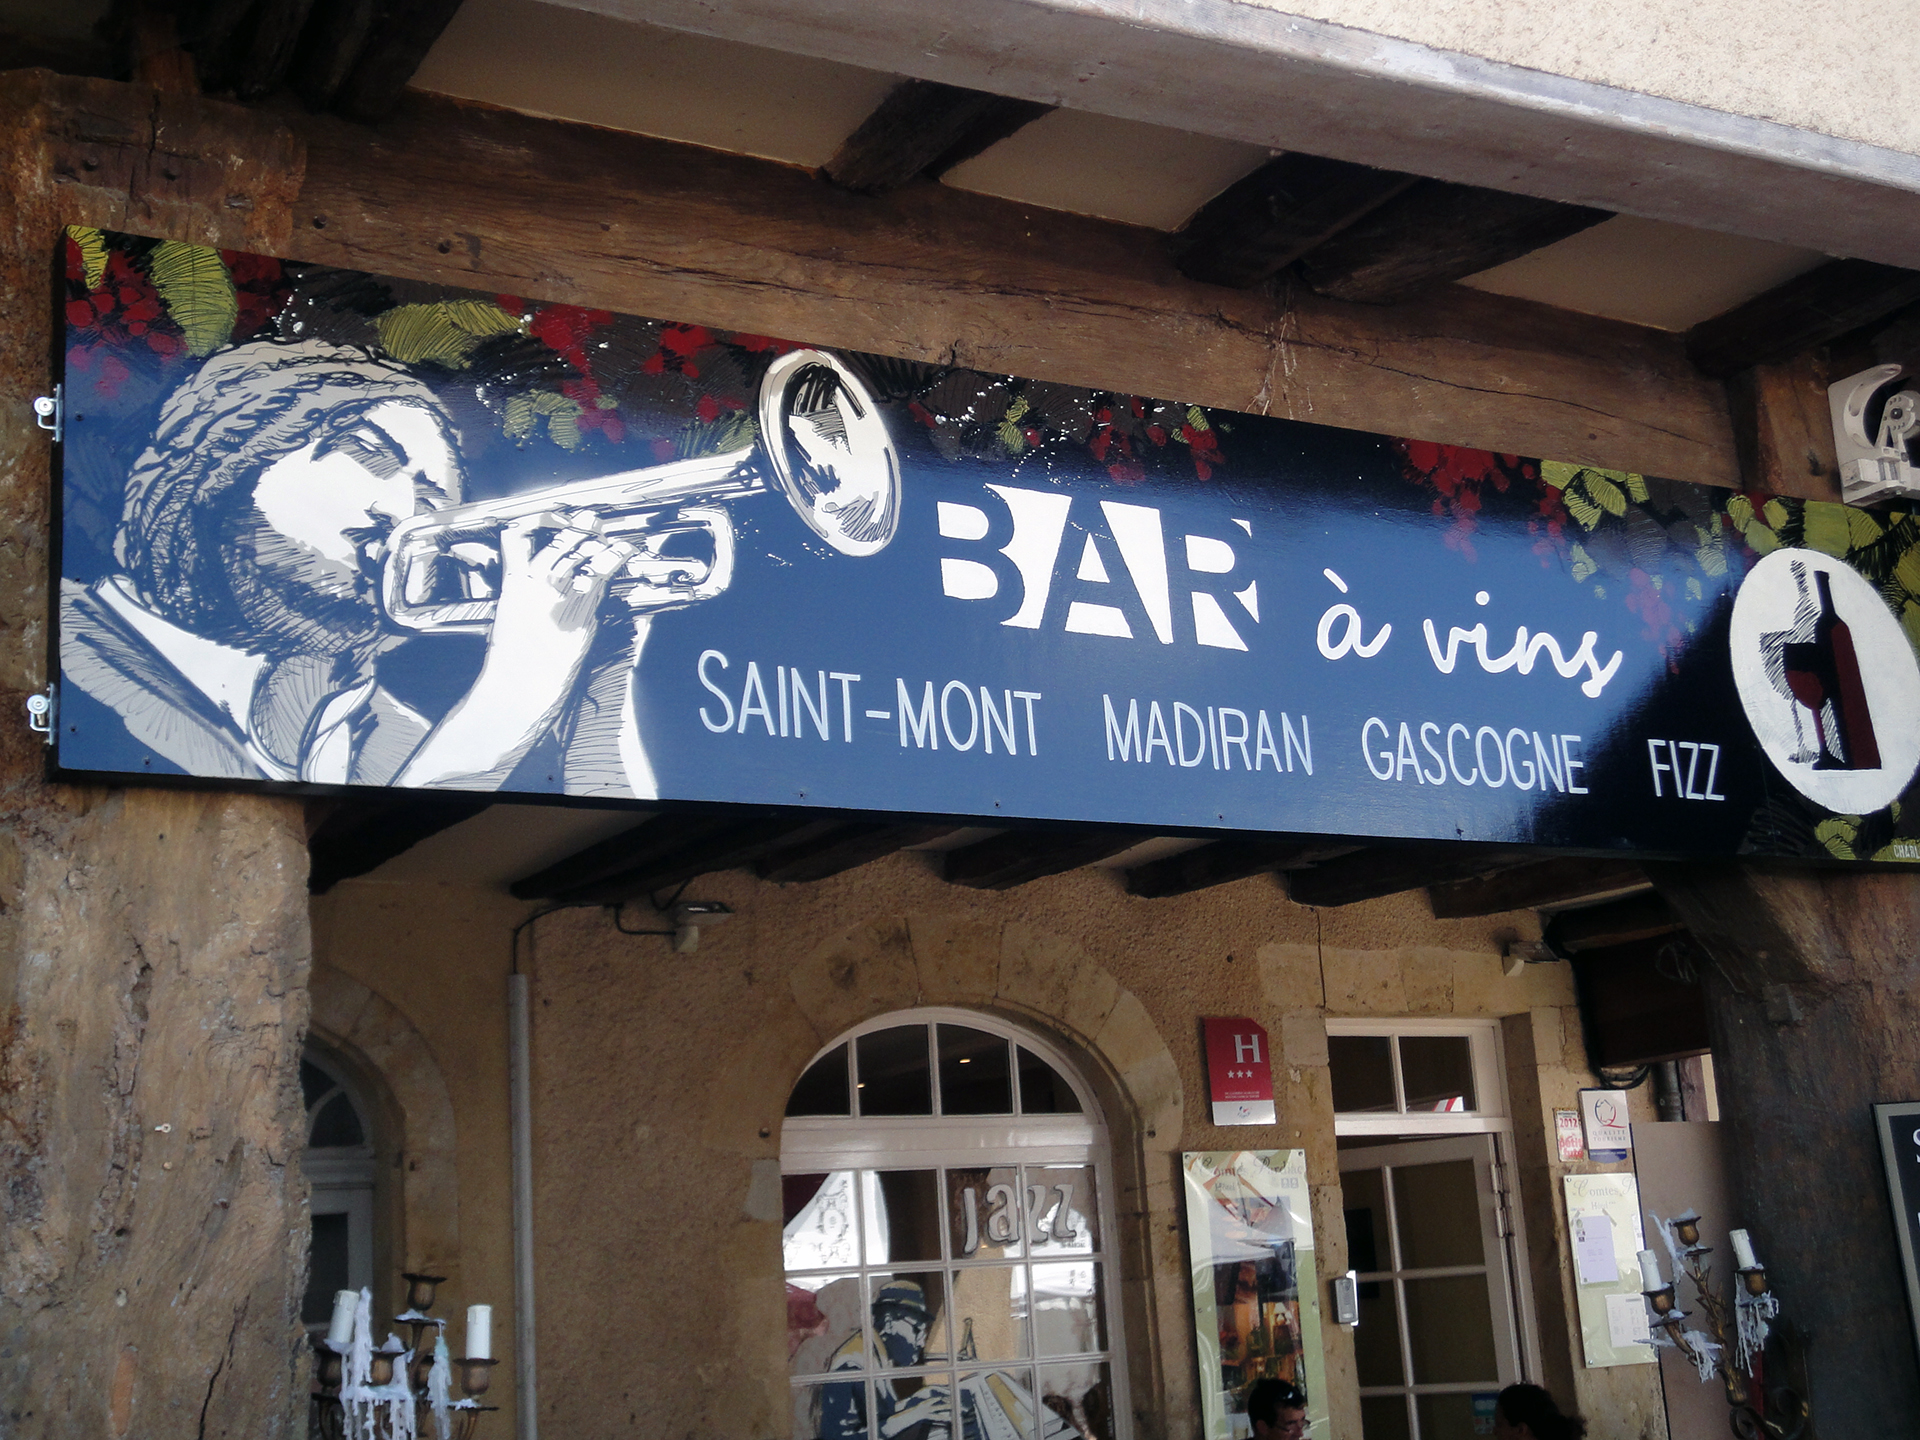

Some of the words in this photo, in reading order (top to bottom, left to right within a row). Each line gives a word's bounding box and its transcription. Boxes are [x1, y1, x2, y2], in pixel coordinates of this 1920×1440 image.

[936, 483, 1259, 652] BAR
[1317, 568, 1391, 660] à
[1423, 591, 1623, 698] vins
[698, 649, 1042, 757] SAINT-MONT
[1103, 694, 1313, 777] MADIRAN
[1361, 717, 1589, 795] GASCOGNE
[1647, 739, 1725, 801] FIZZ
[1233, 1034, 1263, 1063] H
[1559, 1117, 1578, 1128] 2012
